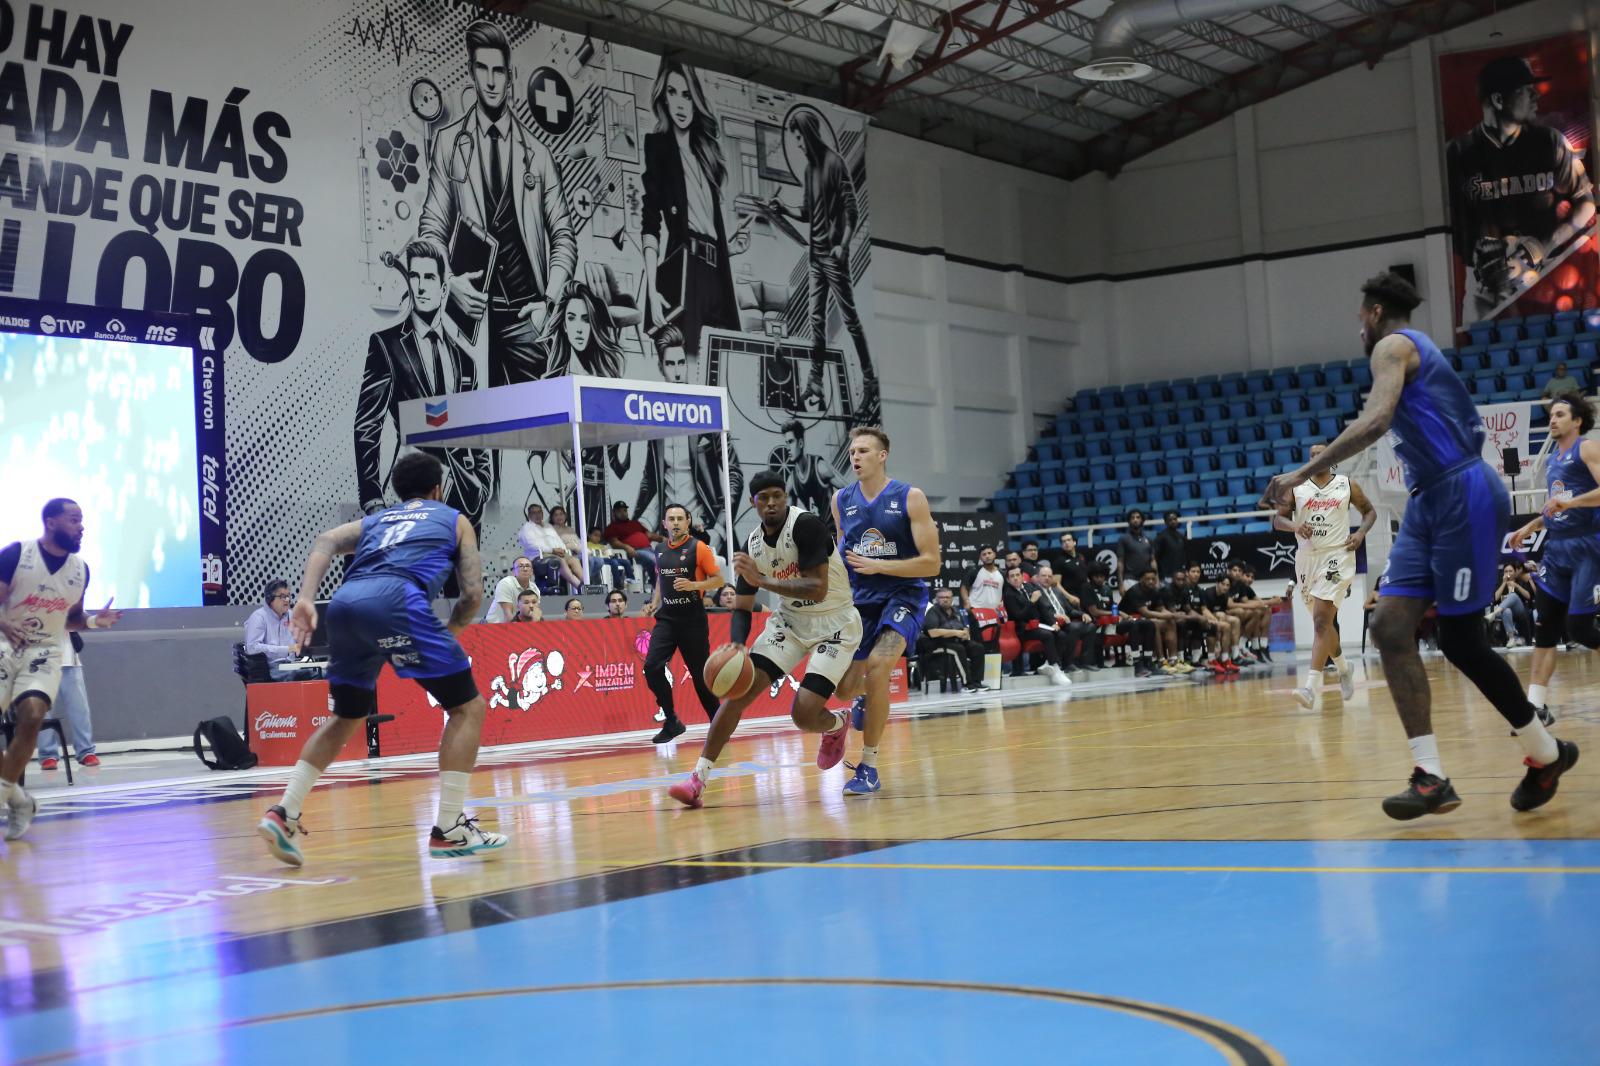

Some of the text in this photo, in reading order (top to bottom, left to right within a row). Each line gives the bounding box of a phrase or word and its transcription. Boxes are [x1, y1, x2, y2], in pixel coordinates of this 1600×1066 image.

[24, 3, 134, 77] HAY
[0, 60, 292, 184] ADA MÁS
[0, 153, 304, 247] ANDE QUE SER
[56, 318, 86, 334] TVP
[94, 331, 138, 342] Banco Azteca
[145, 325, 178, 342] ms
[202, 356, 215, 430] Chevron
[624, 393, 712, 424] Chevron
[1482, 411, 1517, 432] ULLO
[202, 454, 220, 526] telcel
[1454, 567, 1472, 602] 0
[596, 662, 634, 677] IMDEM
